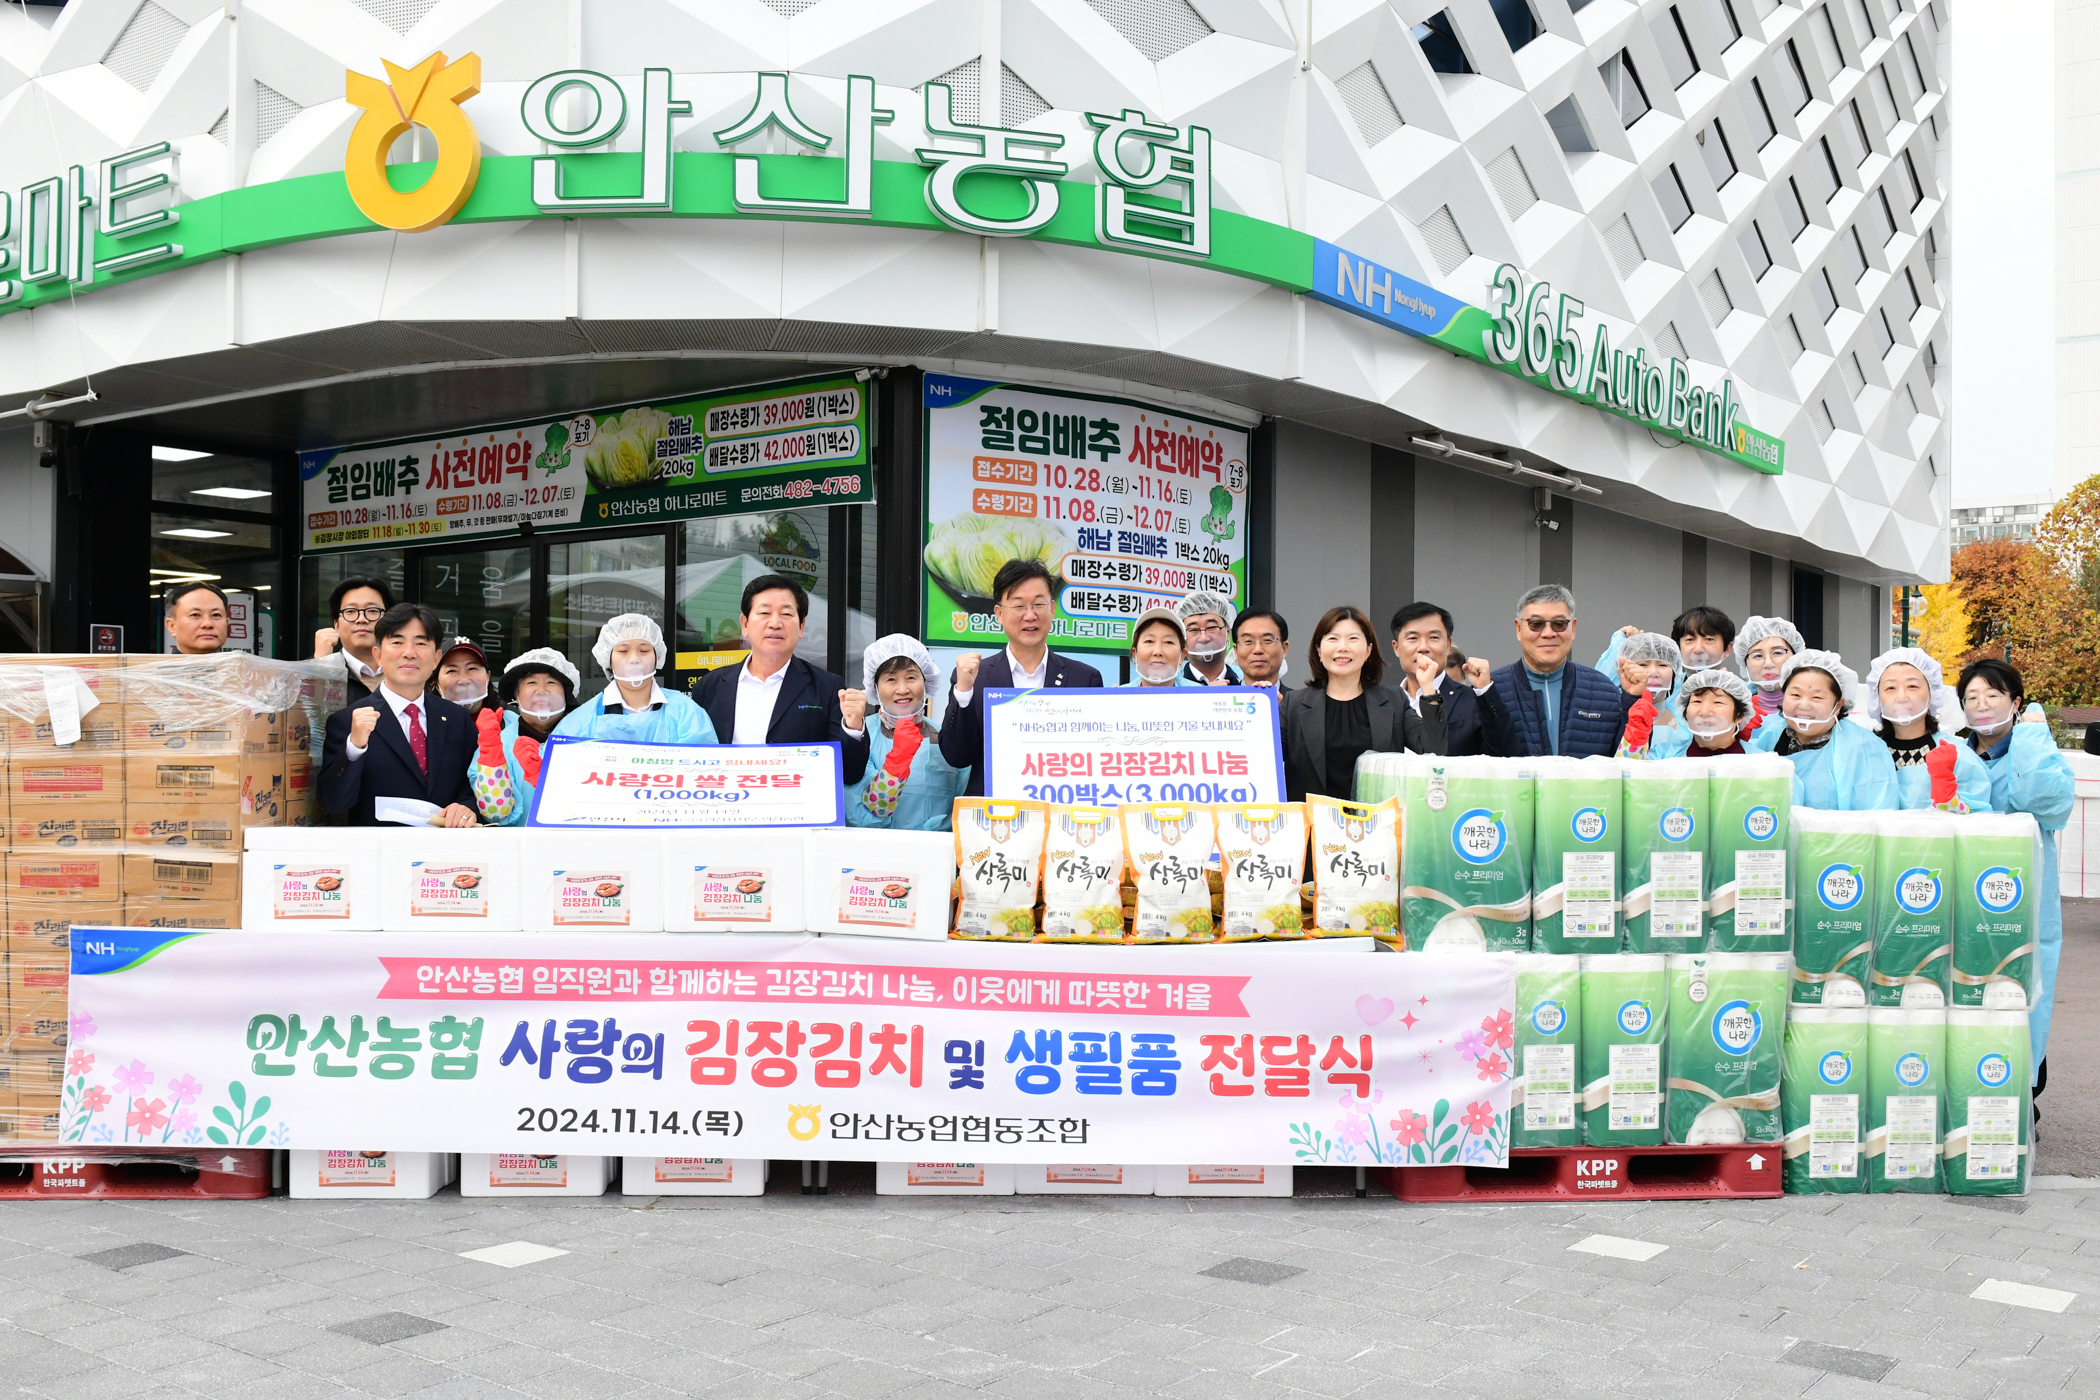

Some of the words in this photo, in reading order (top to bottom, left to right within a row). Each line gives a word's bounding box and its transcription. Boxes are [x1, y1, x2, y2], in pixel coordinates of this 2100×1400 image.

[520, 67, 1211, 259] 안산농협
[0, 141, 184, 300] 마트
[1337, 252, 1392, 315] NH
[1394, 287, 1436, 321] NongHyup
[1482, 262, 1584, 391] 365
[1580, 323, 1665, 420] Auto
[1668, 357, 1741, 454] Bank
[930, 384, 951, 397] NH
[710, 407, 760, 431] 매장수령가
[763, 397, 815, 425] 39,000원
[817, 392, 855, 418] (1박스)
[668, 417, 693, 437] 해남
[574, 431, 591, 443] 포기
[656, 435, 703, 459] 절임배추
[709, 444, 760, 468] 배달수령가
[764, 434, 816, 461] 42,000원
[817, 429, 855, 455] (1박스)
[979, 405, 1121, 462] 절임배추
[1128, 424, 1223, 483] 사전예약
[1745, 433, 1779, 466] 안산농협
[303, 460, 316, 469] NH
[664, 459, 694, 478] 20kg
[327, 455, 420, 504] 절임배추
[425, 440, 532, 490] 사전예약
[977, 461, 1034, 482] 접수기간
[1230, 477, 1243, 489] 포기
[611, 497, 660, 517] 안산농협
[664, 490, 727, 511] 하나로마트
[740, 484, 783, 503] 문의전화
[784, 475, 861, 499] 482-4756
[438, 499, 468, 513] 수령기간
[977, 493, 1034, 514] 수령기간
[309, 513, 336, 527] 접수기간
[1077, 526, 1112, 552] 해남
[1117, 529, 1168, 558] 절임배추
[1175, 541, 1200, 563] 1박스
[1203, 547, 1230, 571] 20kg
[763, 556, 791, 569] LOCAL
[792, 560, 817, 573] FOOD
[1071, 558, 1143, 584] 매장수령가
[1145, 566, 1196, 589] 39,000원
[1199, 571, 1232, 595] (1박스)
[1070, 590, 1143, 614] 배달수령가
[1019, 722, 1067, 733] NH농협과
[1070, 721, 1113, 732] 함께하는
[1116, 721, 1140, 733] 나눔,
[1142, 721, 1174, 732] 따뜻한
[1177, 721, 1199, 731] 겨울
[1201, 720, 1244, 731] 보내세요
[678, 757, 720, 766] 드시고
[1021, 752, 1092, 777] 사랑의
[1100, 751, 1195, 776] 김장김치
[1202, 751, 1249, 776] 나눔
[581, 771, 684, 788] 사랑의
[694, 773, 728, 788] 쌀
[736, 773, 804, 788] 전달
[633, 789, 750, 802] (1,000kg)
[38, 820, 76, 838] 진라면
[150, 819, 189, 838] 진라면
[1463, 825, 1496, 838] 깨끗한
[1323, 843, 1346, 855] New
[1469, 839, 1490, 851] 나라
[970, 846, 991, 866] New
[1051, 850, 1075, 862] New
[1139, 851, 1163, 863] New
[1228, 849, 1252, 862] New
[975, 852, 1028, 893] 상록미
[1056, 855, 1111, 890] 상록미
[1150, 855, 1204, 893] 상록미
[1237, 854, 1292, 890] 상록미
[1330, 851, 1385, 887] 상록미
[1454, 870, 1471, 880] 순수
[1472, 870, 1504, 881] 프리미엄
[283, 881, 308, 890] 사랑의
[420, 878, 446, 888] 사랑의
[704, 883, 729, 892] 사랑의
[1827, 878, 1855, 888] 깨끗한
[1905, 882, 1933, 893] 깨끗한
[1985, 881, 2013, 891] 깨끗한
[283, 891, 320, 901] 김장김치
[322, 892, 341, 900] 나눔
[420, 888, 458, 899] 김장김치
[460, 889, 478, 899] 나눔
[562, 886, 587, 896] 사랑의
[849, 885, 875, 896] 사랑의
[1831, 890, 1849, 899] 나라
[1990, 892, 2008, 901] 나라
[562, 897, 600, 907] 김장김치
[602, 898, 621, 907] 나눔
[704, 894, 741, 903] 김장김치
[744, 894, 762, 903] 나눔
[848, 895, 887, 908] 김장김치
[889, 899, 908, 909] 나눔
[1909, 893, 1927, 903] 나라
[1993, 923, 2021, 933] 프리미엄
[86, 942, 115, 956] NH
[417, 964, 524, 994] 안산농협
[532, 966, 642, 996] 임직원과
[650, 966, 758, 996] 함께하는
[766, 968, 873, 998] 김장김치
[882, 970, 944, 1002] 나눔,
[952, 976, 1061, 1006] 이웃에게
[1068, 979, 1150, 1009] 따뜻한
[1158, 982, 1212, 1011] 겨울
[1723, 1018, 1752, 1029] 깨끗한
[1728, 1030, 1747, 1042] 나라
[246, 1013, 485, 1080] 안산농협
[500, 1017, 665, 1084] 사랑의
[685, 1018, 925, 1089] 김장김치
[943, 1039, 986, 1090] 및
[1004, 1028, 1181, 1097] 생필품
[1199, 1033, 1375, 1099] 전달식
[1984, 1062, 2004, 1071] 깨끗한
[1905, 1070, 1919, 1079] 나라
[516, 1106, 744, 1138] 2024.11.14.(목)
[829, 1112, 1091, 1145] 안산농업협동조합
[42, 1158, 86, 1174] KPP
[328, 1158, 365, 1168] 김장김치
[367, 1159, 386, 1168] 나눔
[499, 1159, 537, 1169] 김장김치
[539, 1160, 558, 1169] 나눔
[1576, 1160, 1618, 1176] KPP
[43, 1178, 86, 1188] 한국파렛트풀
[1577, 1179, 1618, 1189] 한국파렛트풀
